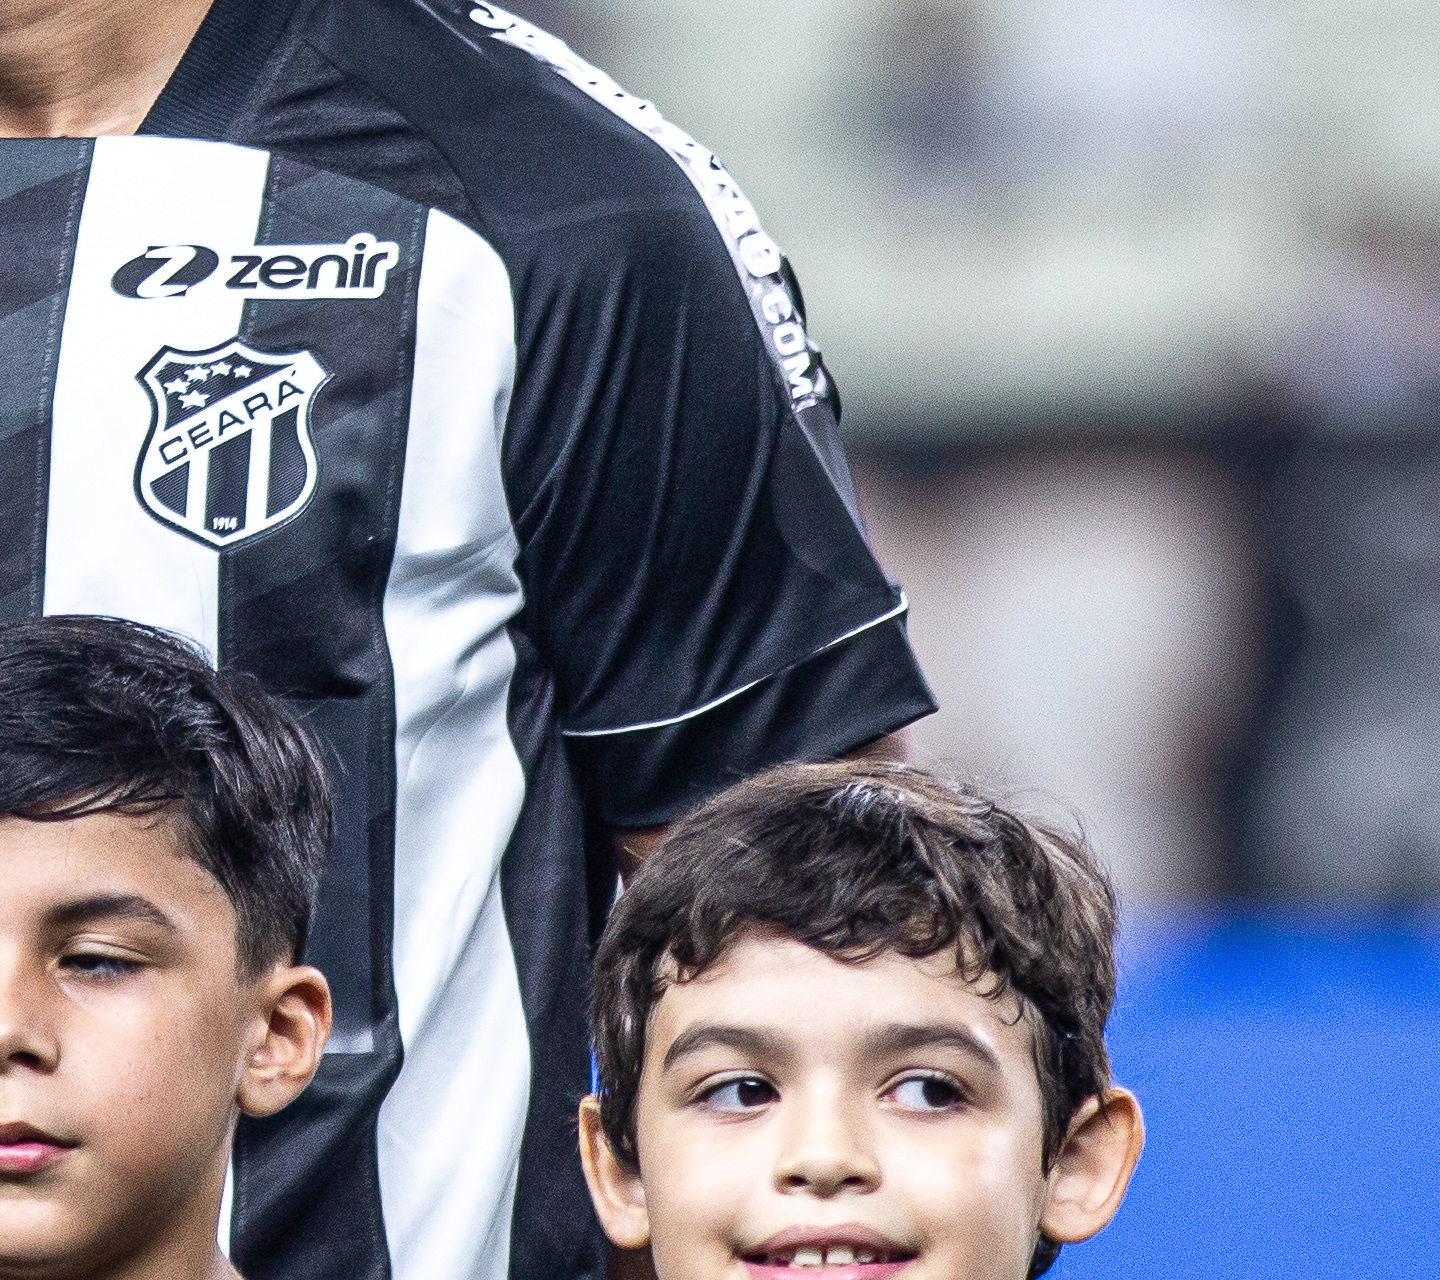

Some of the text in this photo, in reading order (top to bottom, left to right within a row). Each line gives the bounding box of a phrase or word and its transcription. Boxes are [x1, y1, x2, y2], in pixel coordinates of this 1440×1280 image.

[225, 242, 388, 290] zenir
[158, 370, 306, 466] CEARÁ
[212, 516, 238, 532] 1914
